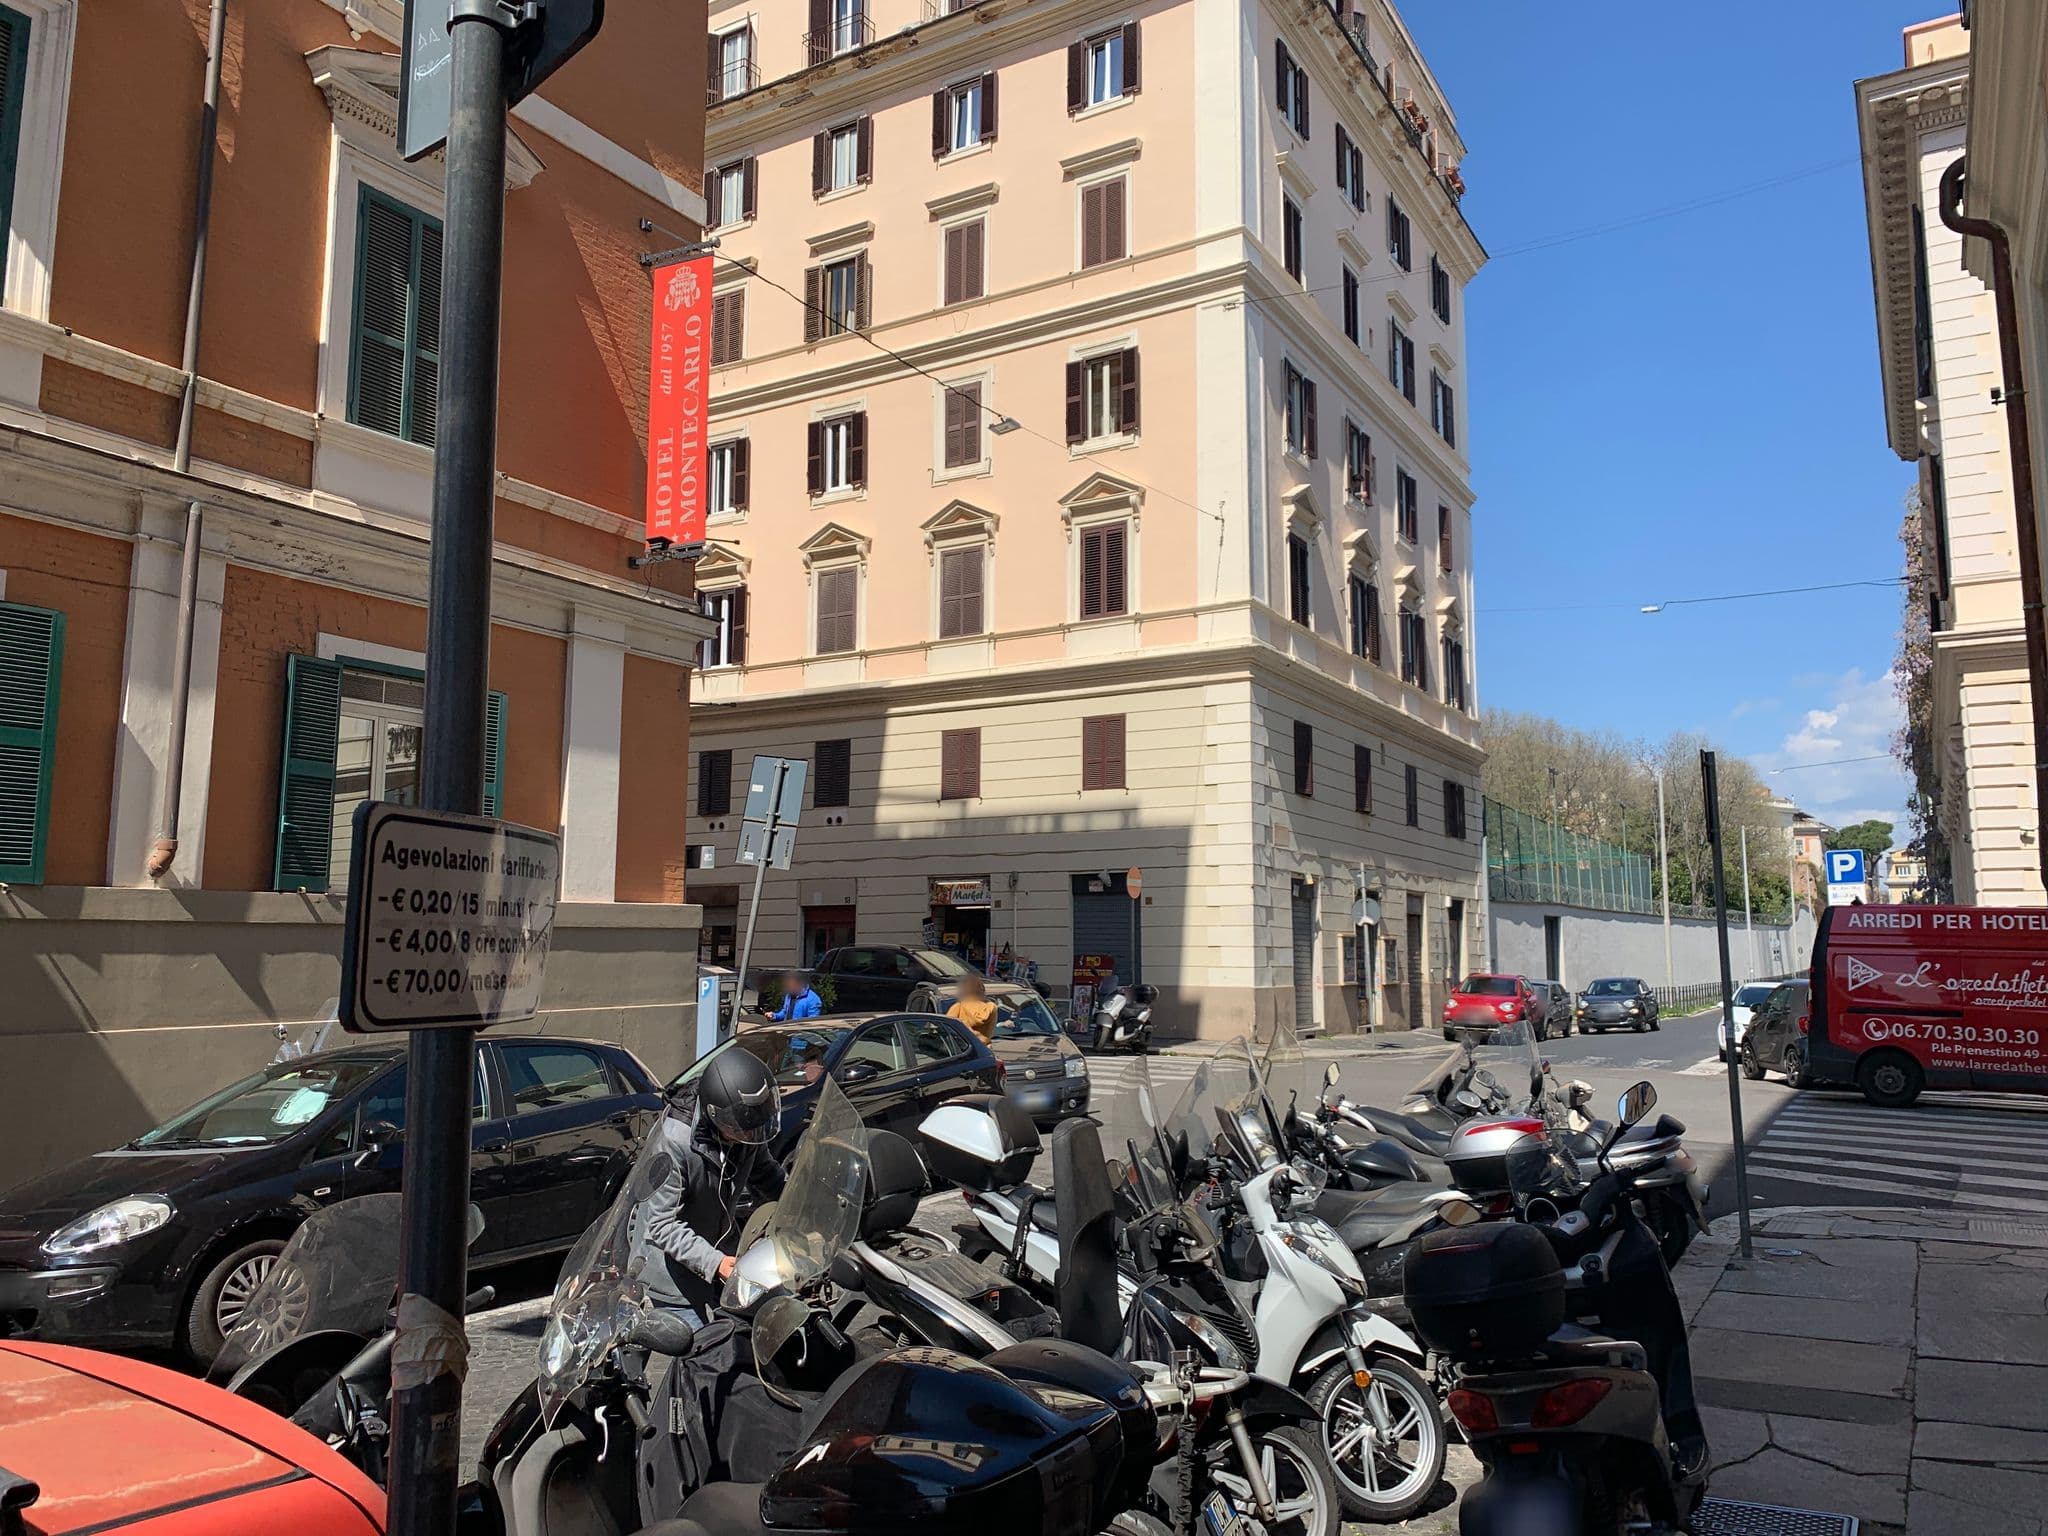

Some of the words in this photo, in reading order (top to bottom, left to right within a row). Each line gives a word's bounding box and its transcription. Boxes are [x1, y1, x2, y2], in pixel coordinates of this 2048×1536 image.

[661, 321, 675, 360] 1957
[659, 362, 673, 396] dal
[679, 314, 703, 526] MONTECARLO
[654, 427, 675, 528] HOTEL
[381, 840, 495, 873] Agevolazioni
[1833, 853, 1857, 881] P
[952, 890, 984, 901] Market
[1848, 913, 1922, 929] ARREDI
[1932, 913, 1972, 930] PER
[1982, 914, 2048, 931] HOTEL
[475, 935, 497, 954] ore
[1892, 1022, 2040, 1046] 06.70.30.30.30
[1931, 1042, 1952, 1054] P.le
[1954, 1044, 2022, 1058] Prenestino
[2023, 1049, 2040, 1059] 49
